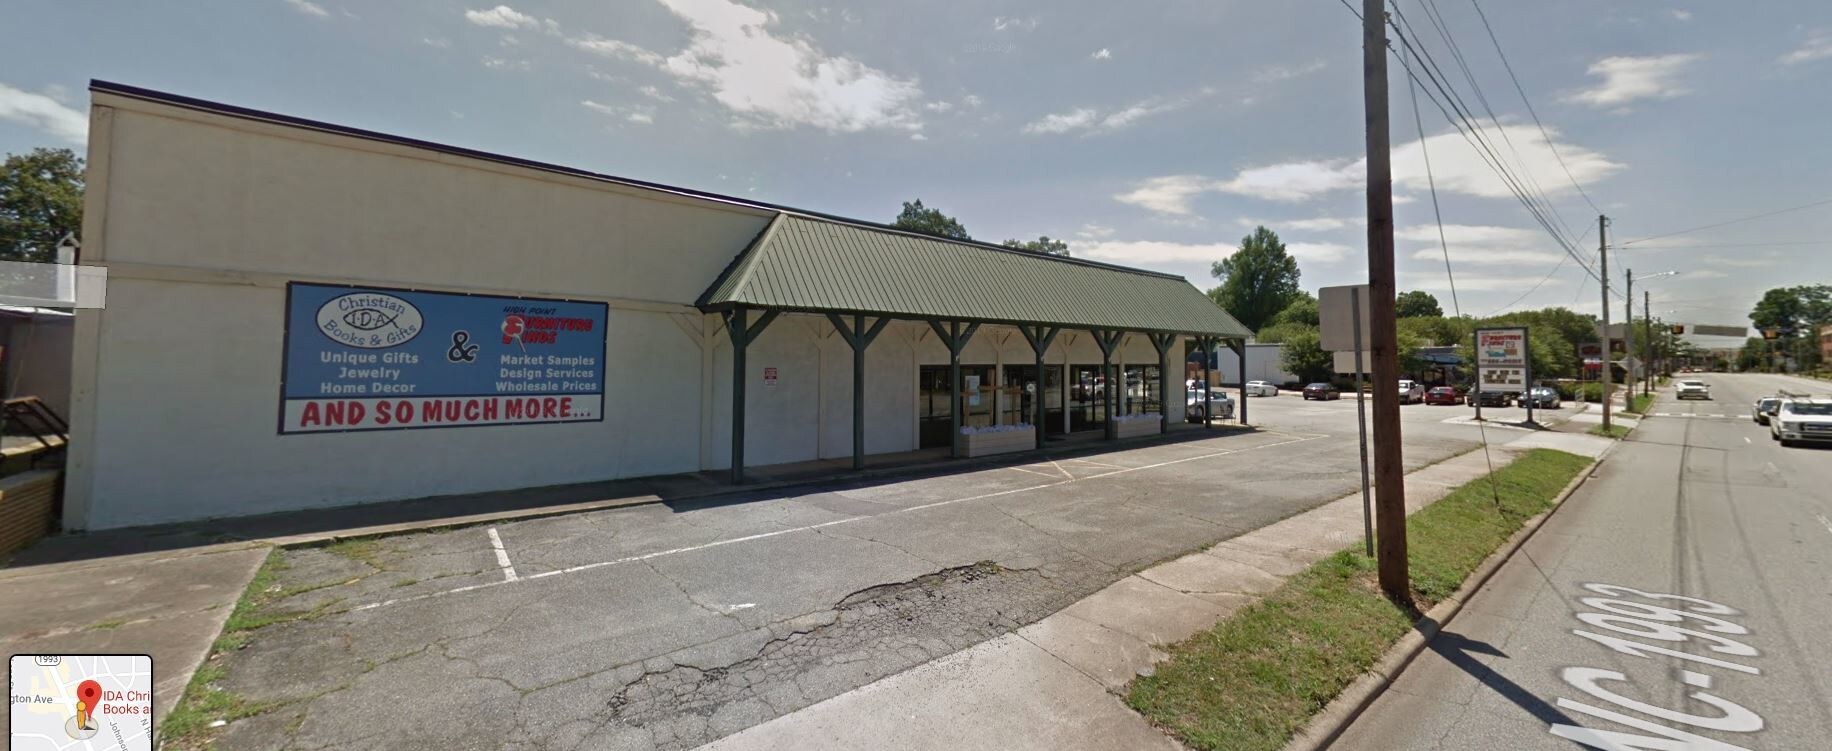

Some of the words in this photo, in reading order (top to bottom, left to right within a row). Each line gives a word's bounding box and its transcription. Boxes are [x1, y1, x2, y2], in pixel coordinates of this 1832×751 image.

[338, 296, 406, 314] Christian
[503, 305, 526, 314] HIGH
[528, 307, 556, 315] POINT
[323, 319, 366, 346] Books
[369, 334, 382, 346] &
[386, 324, 417, 344] Gifts
[448, 331, 479, 362] &
[320, 351, 377, 365] Unique
[382, 352, 419, 363] Gifts
[500, 354, 544, 365] Market
[547, 355, 595, 367] Samples
[338, 367, 400, 380] Jewelry
[500, 368, 542, 379] Design
[546, 368, 594, 378] Services
[320, 382, 367, 393] Home
[372, 382, 416, 393] Decor
[495, 381, 559, 392] Wholesale
[562, 381, 597, 391] Prices
[300, 401, 366, 427] AND
[374, 400, 414, 424] SO
[422, 398, 498, 422] MUCH
[504, 397, 591, 420] MORE...
[1549, 582, 1765, 751] NC-1993
